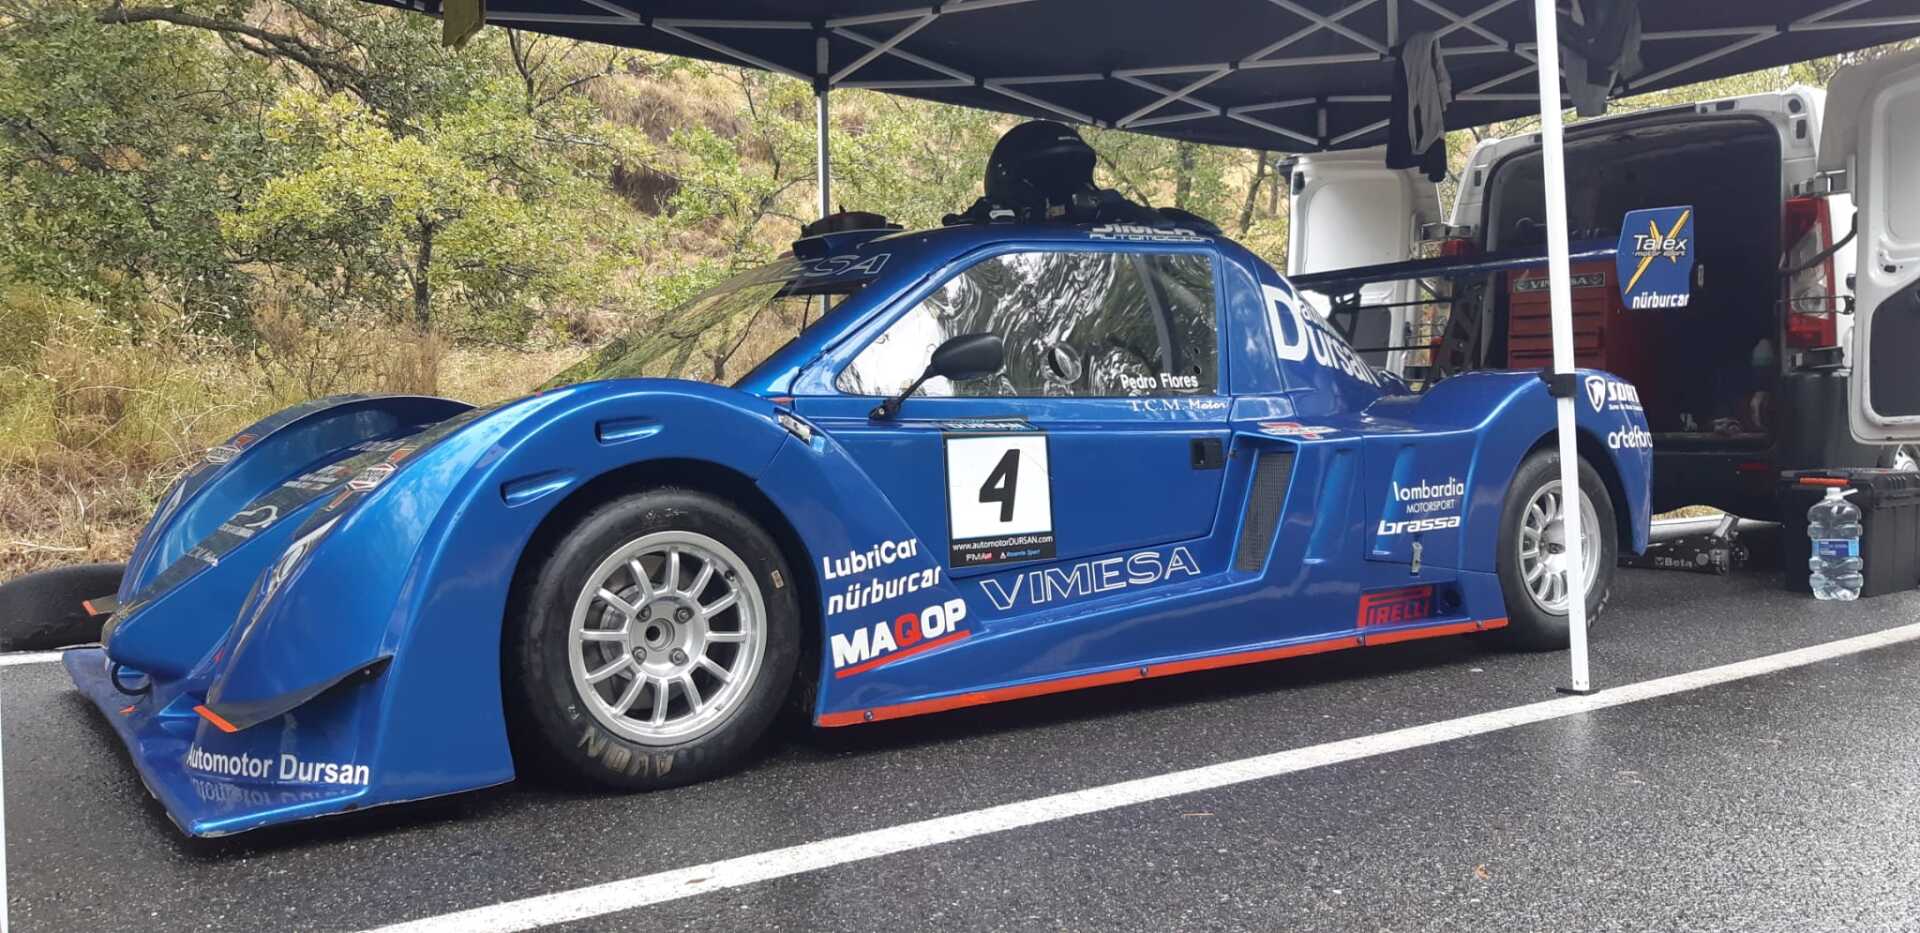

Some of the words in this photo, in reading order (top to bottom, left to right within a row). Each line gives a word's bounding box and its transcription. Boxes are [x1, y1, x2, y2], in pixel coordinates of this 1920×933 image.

[1633, 234, 1688, 251] Talex
[1529, 276, 1588, 289] VISA
[1632, 291, 1690, 310] nürburcar
[1262, 284, 1382, 387] Dursan
[1120, 374, 1157, 389] Pedro
[1160, 373, 1199, 388] Flores
[978, 448, 1021, 523] 4
[1393, 477, 1465, 502] lombardia
[1406, 499, 1455, 513] MOTORSPORT
[1377, 516, 1461, 536] brassa
[823, 537, 918, 580] LubriCar
[952, 536, 1053, 552] www.automotorDURSAN.com
[827, 564, 942, 616] nürburcar
[980, 547, 1200, 611] VIMESA
[1357, 586, 1433, 630] PIRELLI
[830, 598, 968, 668] MAQOP
[186, 742, 273, 778] Automotor
[279, 754, 370, 785] Dursan
